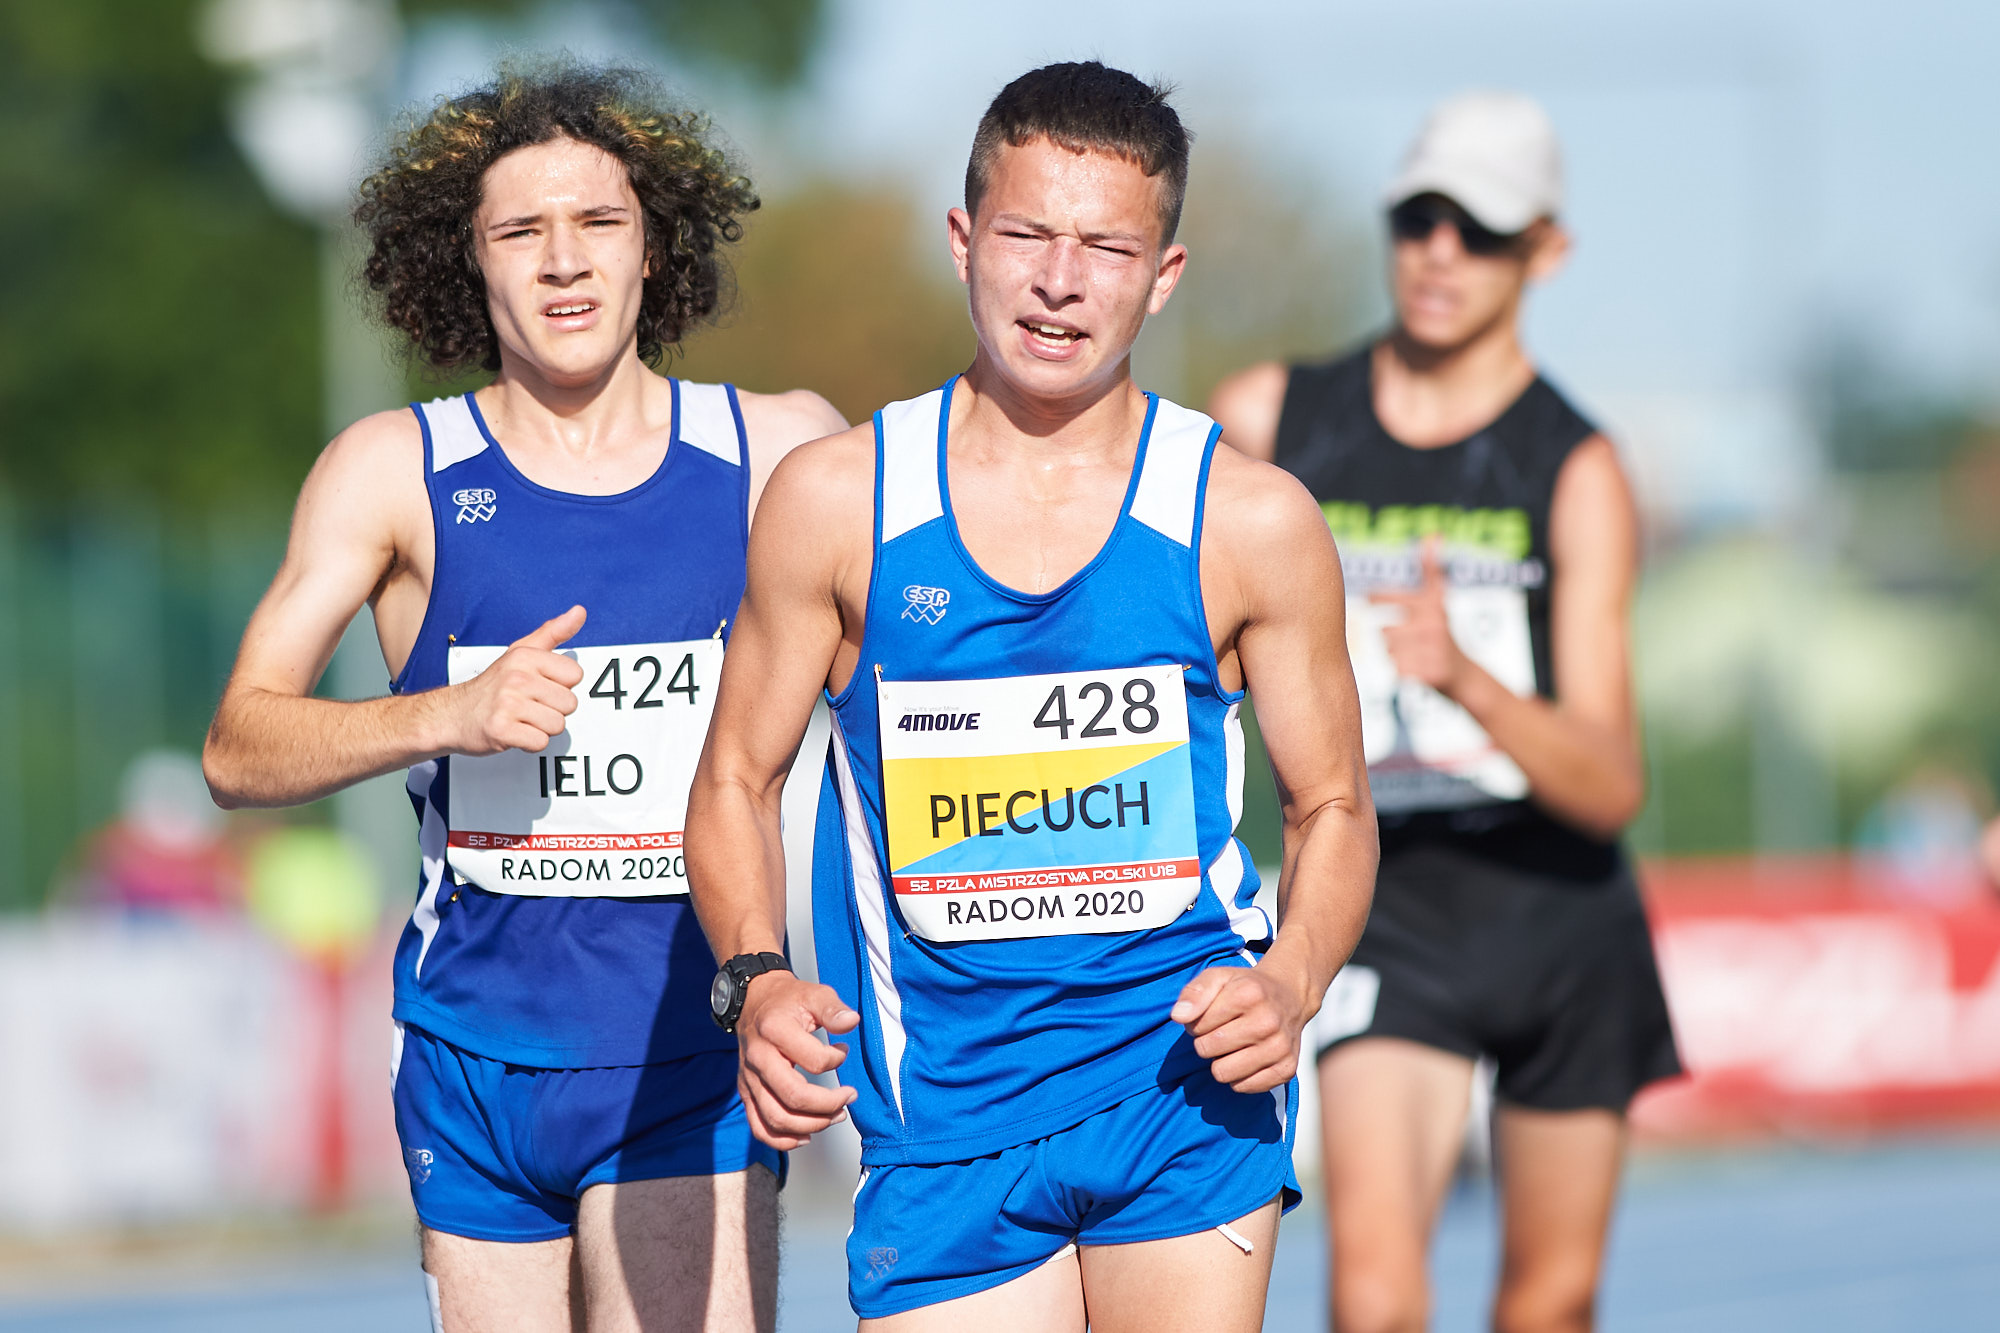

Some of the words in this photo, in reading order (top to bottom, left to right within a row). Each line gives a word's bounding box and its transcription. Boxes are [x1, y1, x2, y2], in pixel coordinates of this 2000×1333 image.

[589, 653, 700, 710] 424
[898, 712, 981, 731] 4MOVE
[1033, 678, 1159, 740] 428
[539, 753, 643, 798] IELO
[929, 780, 1150, 838] PIECUCH
[468, 835, 490, 847] 52.
[493, 836, 529, 849] PZLA
[532, 836, 638, 849] MISTRZOSTWA
[502, 857, 611, 881] RADOM
[622, 856, 686, 881] 2020
[910, 880, 934, 892] 52.
[936, 878, 976, 892] PZLA
[979, 870, 1090, 890] MISTRZOSTWA
[1092, 867, 1146, 882] POLSKI
[1149, 864, 1177, 878] U18
[947, 894, 1065, 925] RADOM
[1074, 889, 1144, 917] 2020
